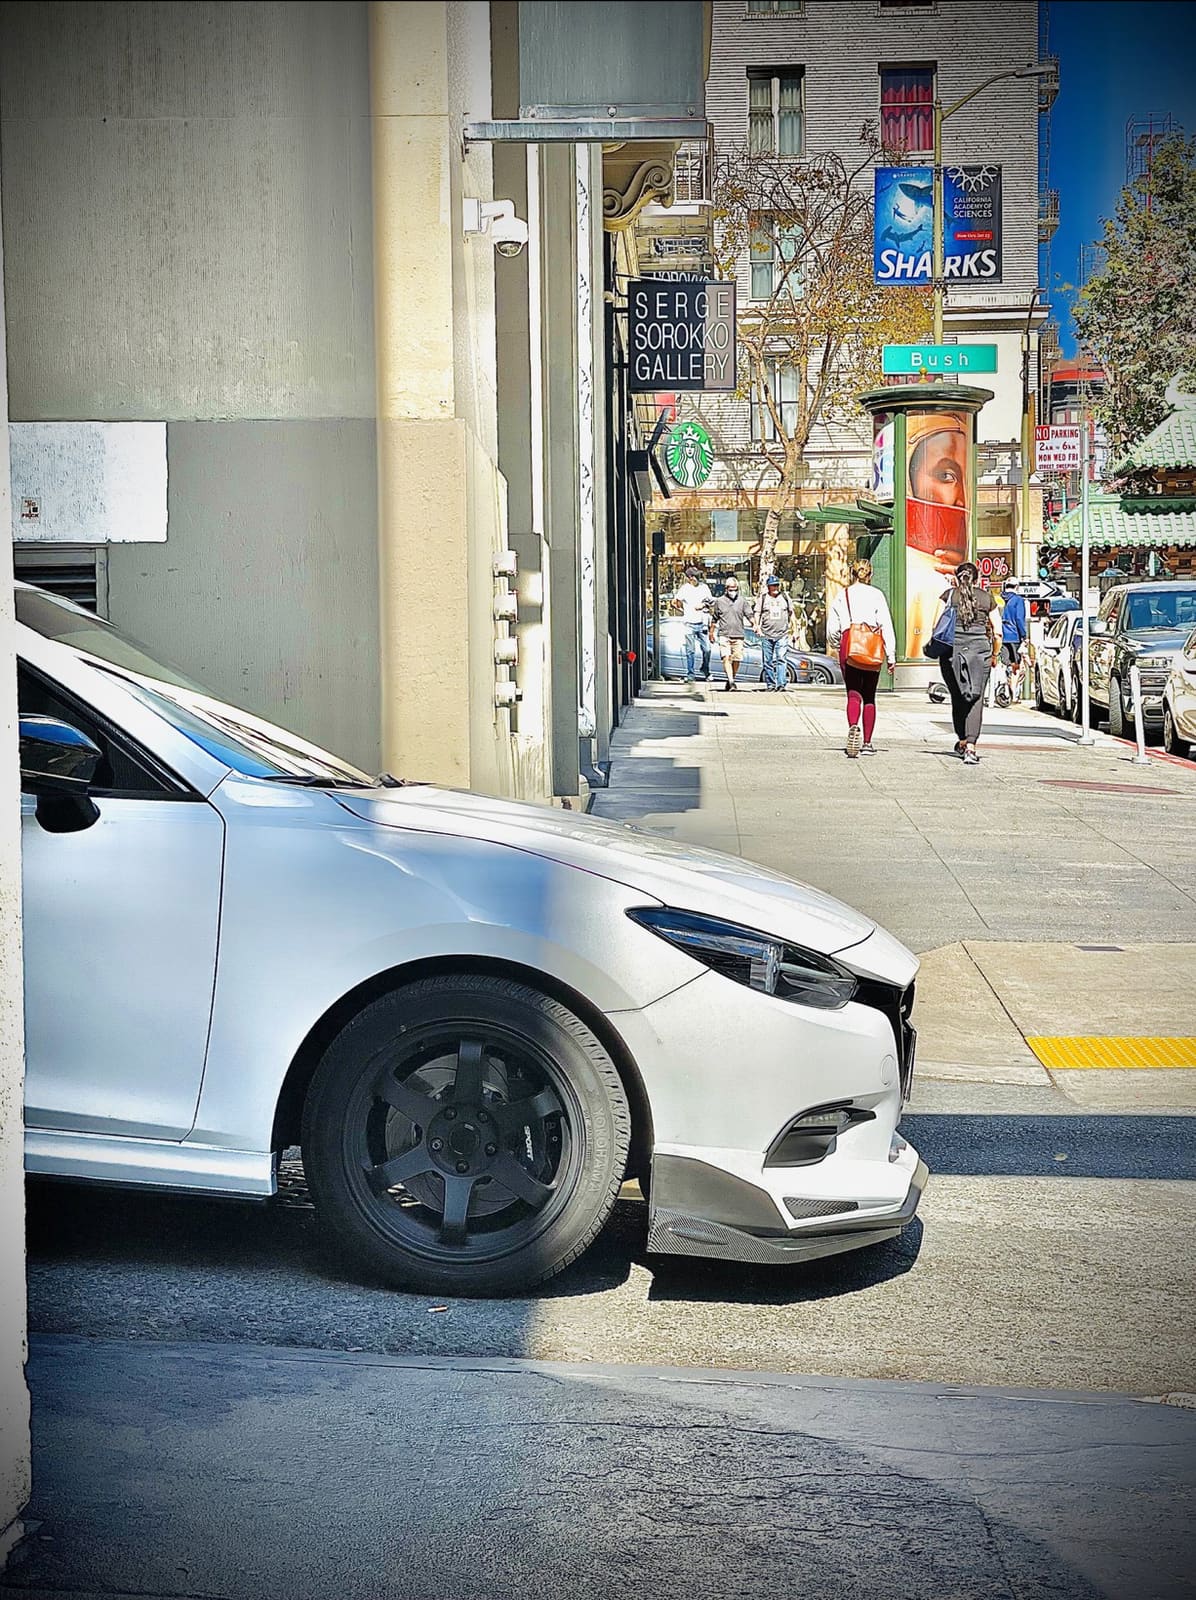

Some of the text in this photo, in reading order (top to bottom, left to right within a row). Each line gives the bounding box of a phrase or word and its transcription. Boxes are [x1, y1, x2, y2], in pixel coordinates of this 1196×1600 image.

[954, 210, 992, 218] SCIENCES
[877, 249, 997, 278] SHARKS
[635, 292, 729, 319] SERGE
[635, 322, 729, 350] SOROKKO
[635, 354, 729, 380] GALLERY
[911, 352, 969, 366] Bush
[1036, 428, 1078, 440] NO PARKING
[524, 1125, 534, 1161] SPORT
[588, 1107, 607, 1193] YOKOHAMA
